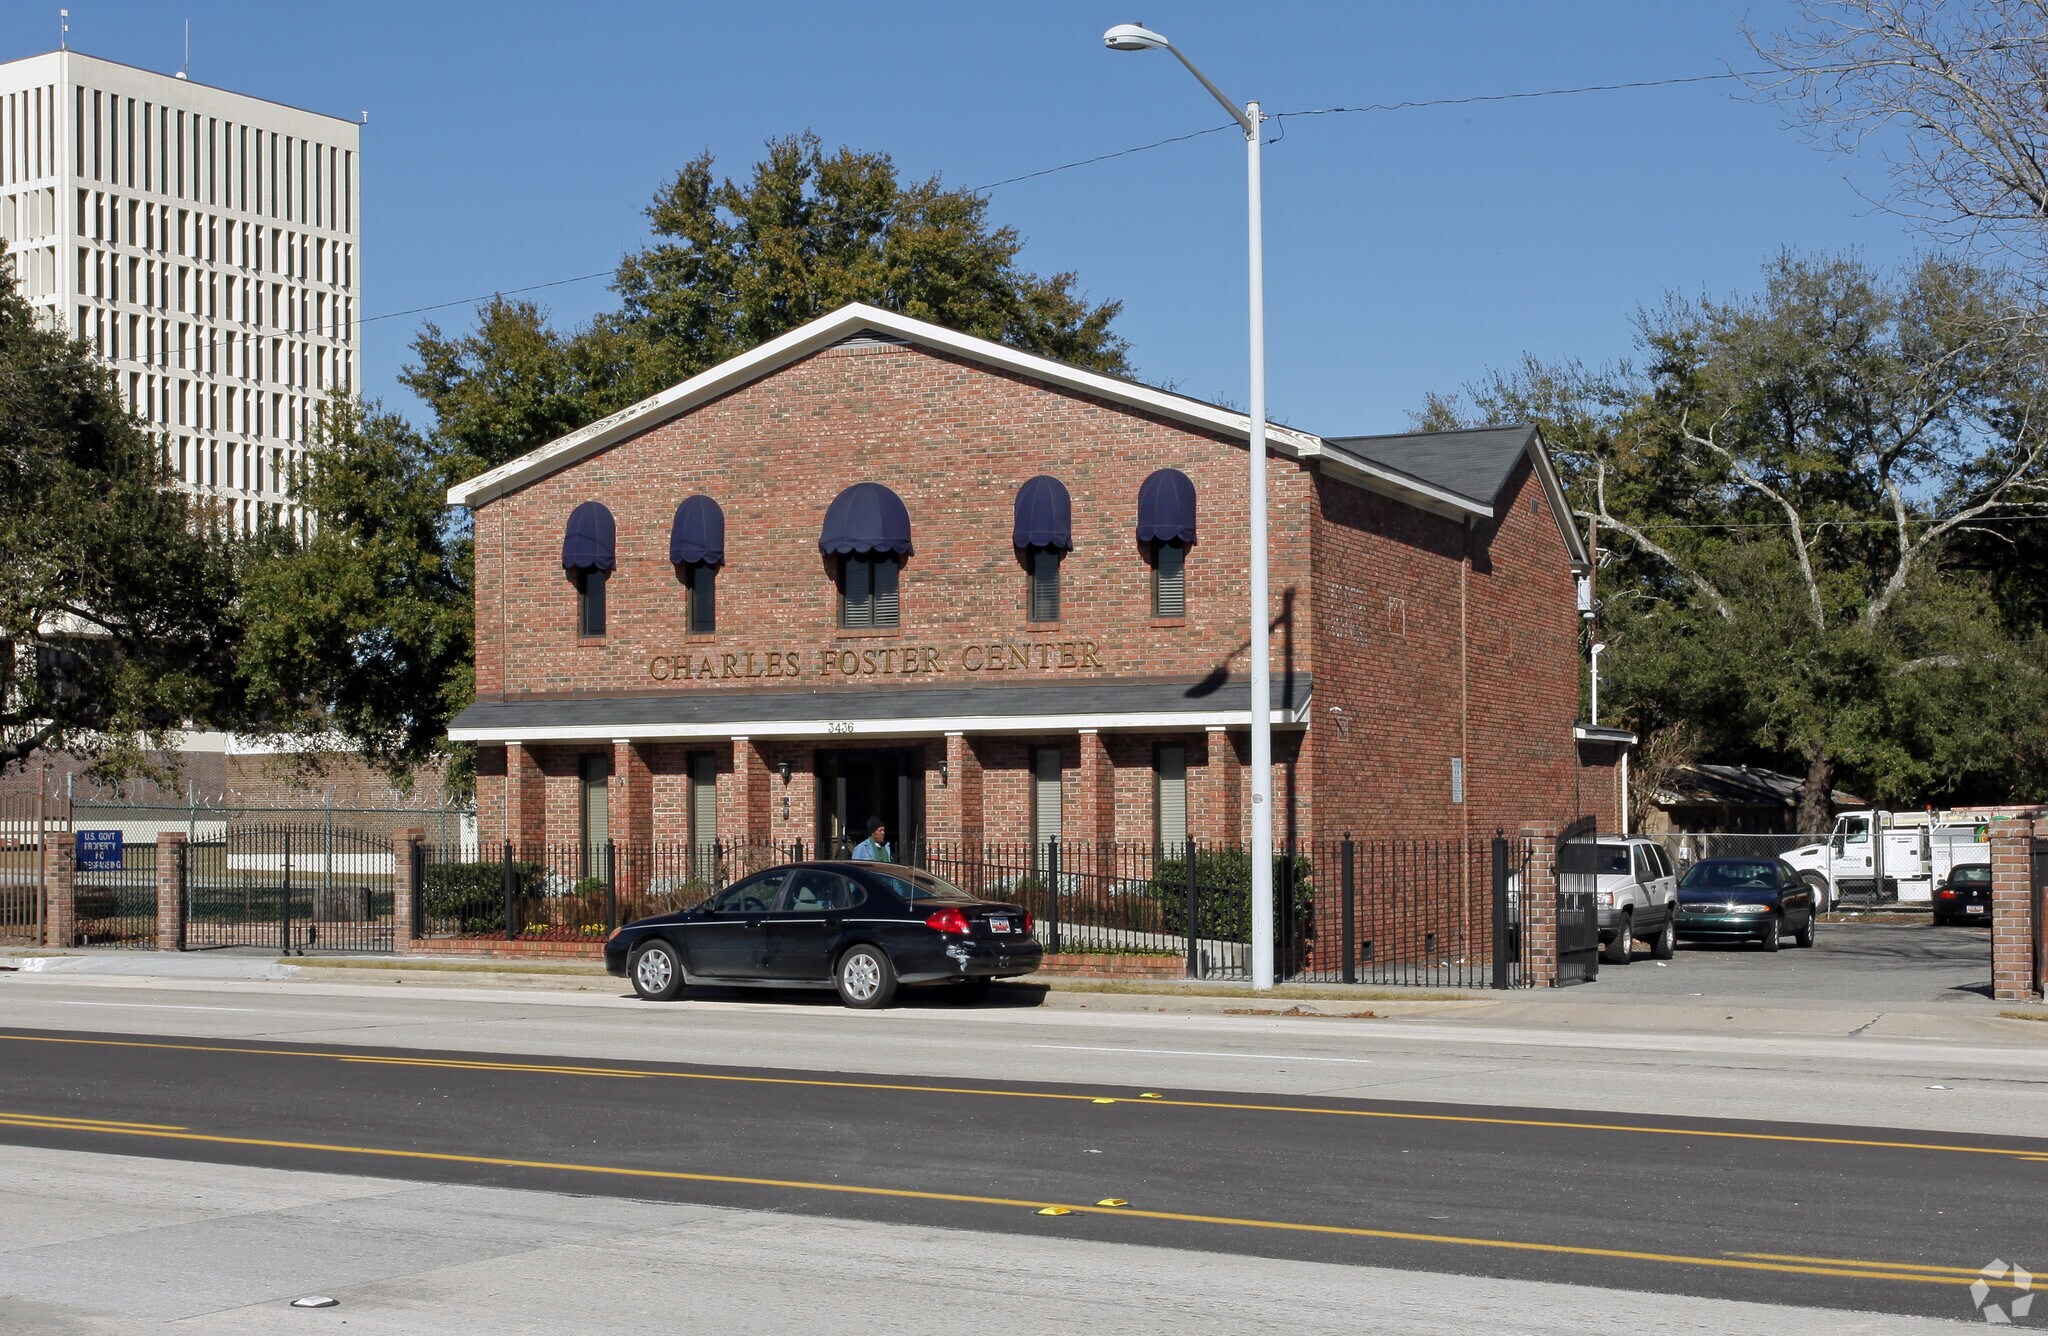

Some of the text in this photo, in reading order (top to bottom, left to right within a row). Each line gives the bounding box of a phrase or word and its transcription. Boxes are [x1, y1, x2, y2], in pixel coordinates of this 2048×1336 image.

[650, 640, 1103, 681] CHARLES FOSTER CENTER
[828, 722, 854, 733] 3436
[84, 832, 96, 841] U.S.
